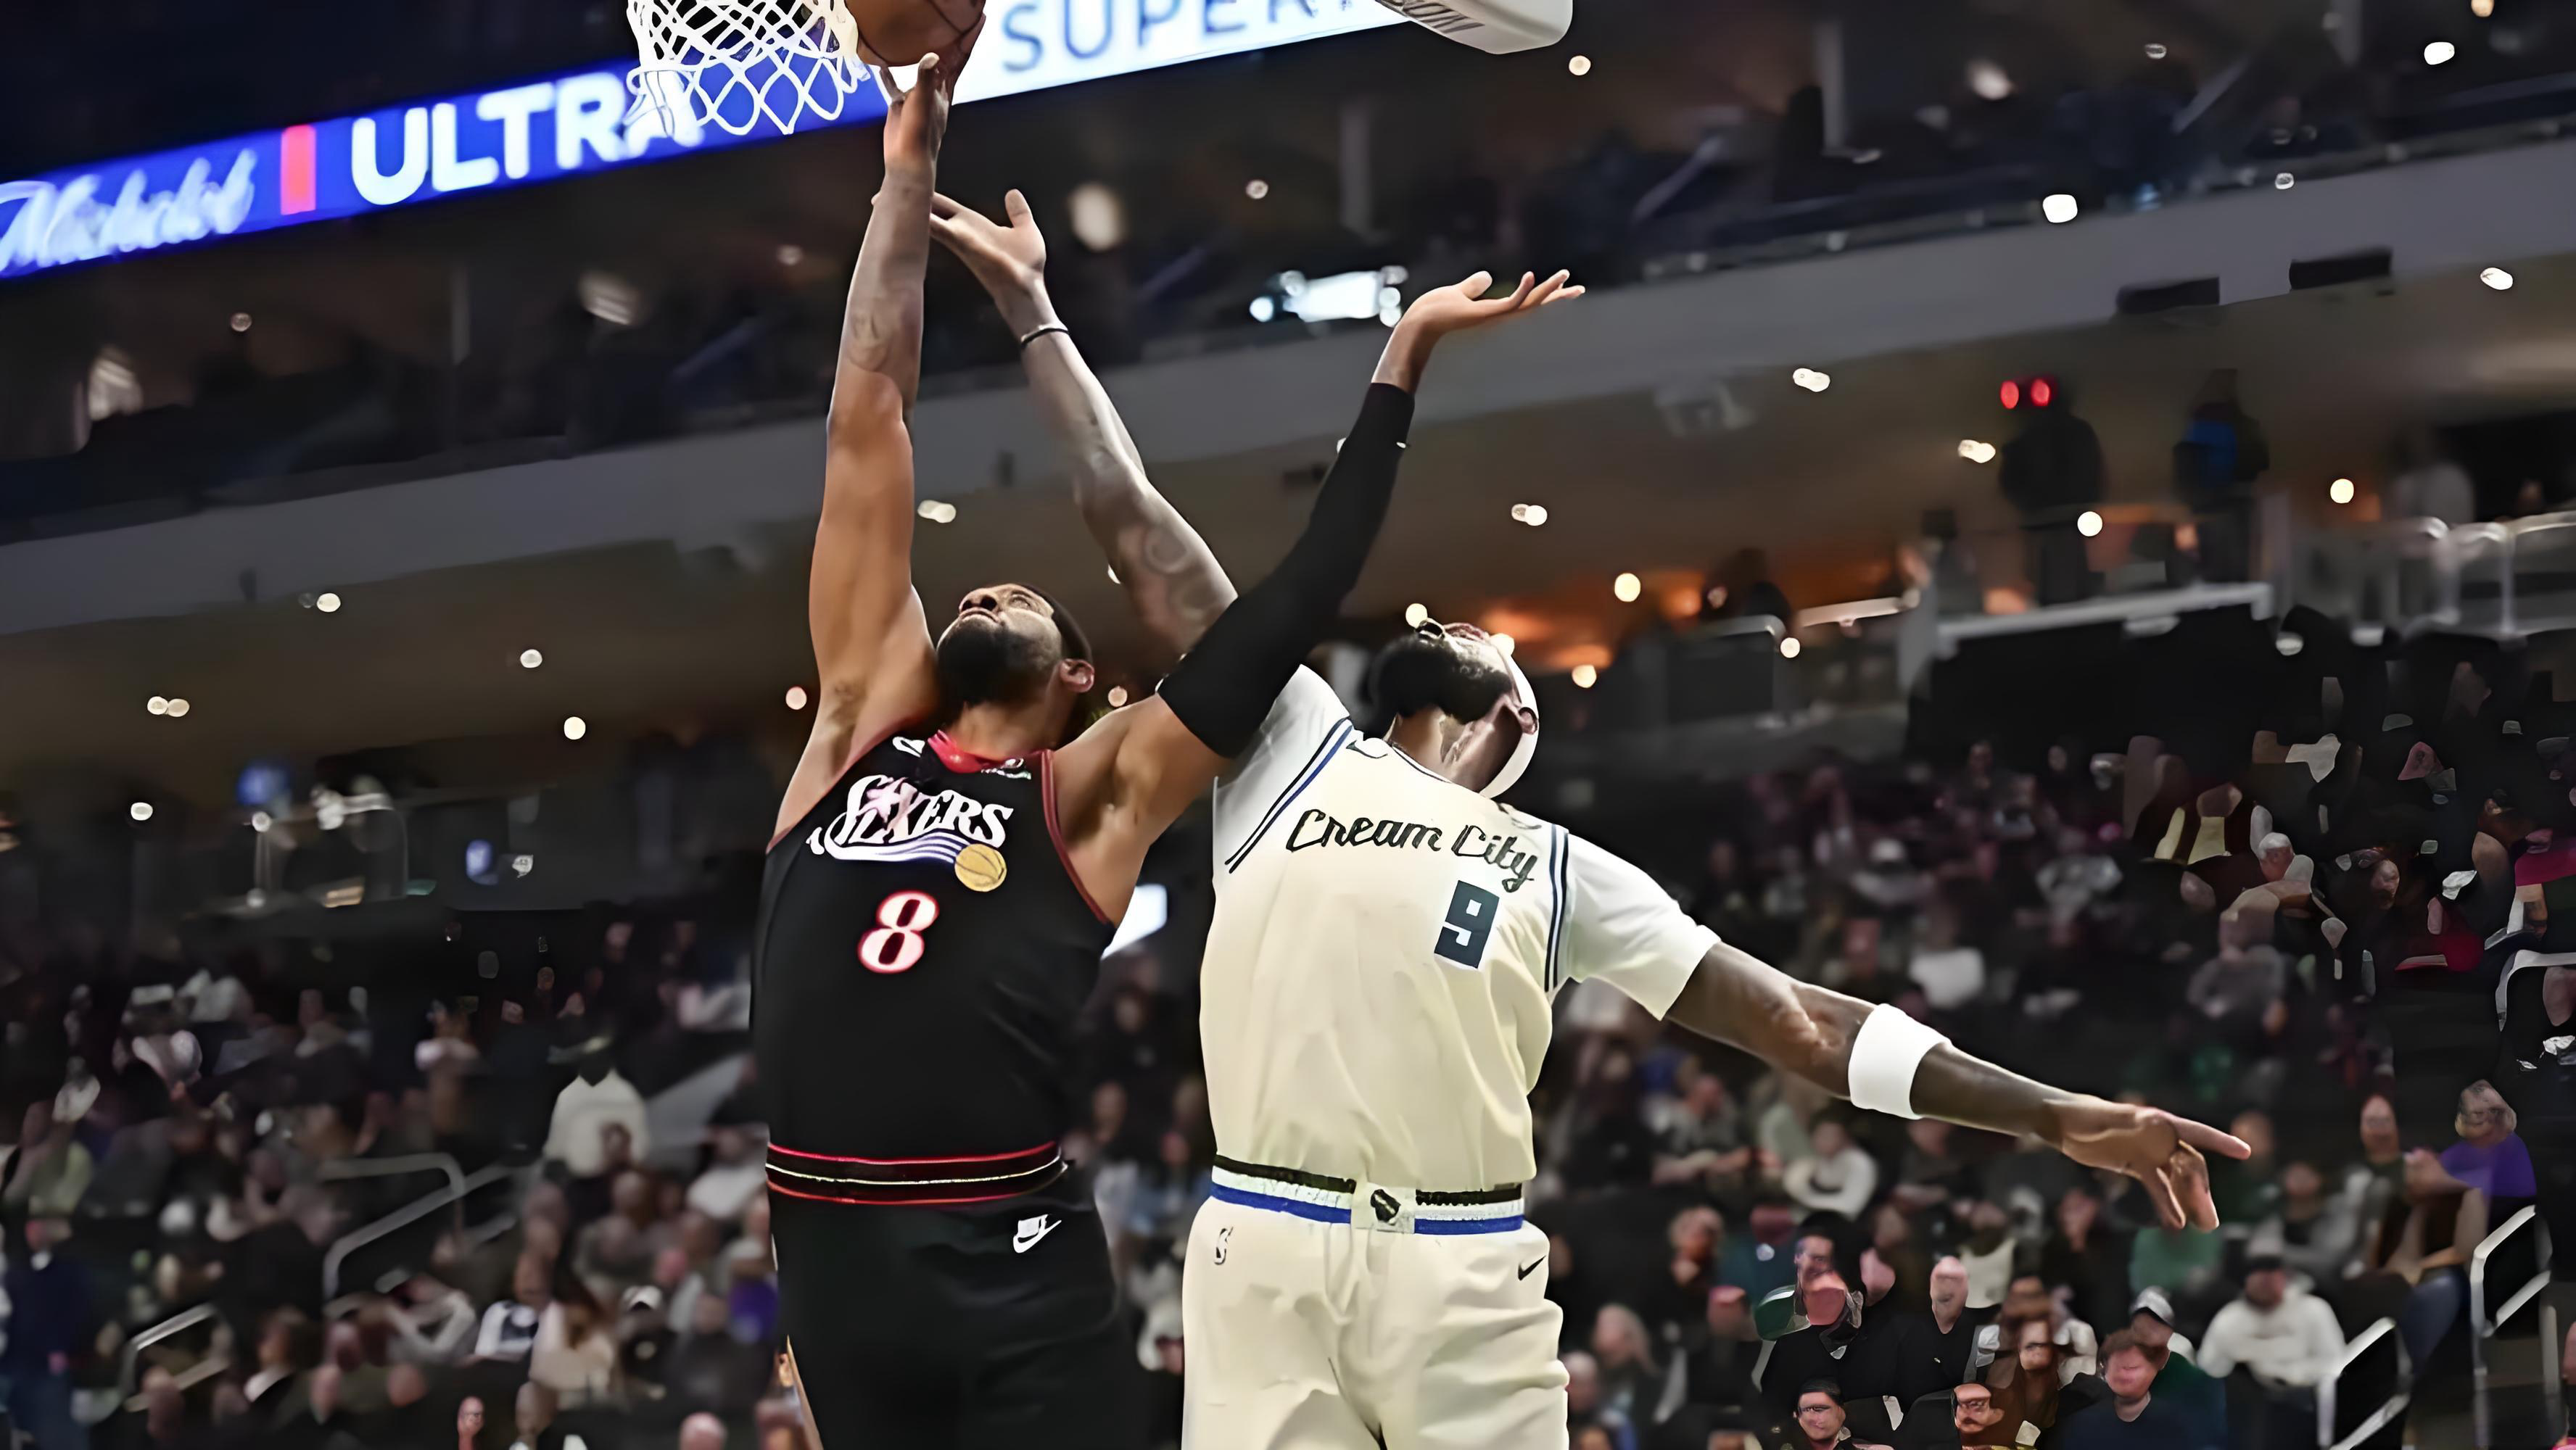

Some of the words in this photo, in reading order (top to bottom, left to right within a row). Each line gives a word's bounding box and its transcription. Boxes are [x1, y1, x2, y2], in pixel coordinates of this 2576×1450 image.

[1286, 808, 1442, 853] Cream
[1451, 824, 1539, 893] City
[857, 890, 940, 974] 8
[1434, 880, 1500, 969] 9
